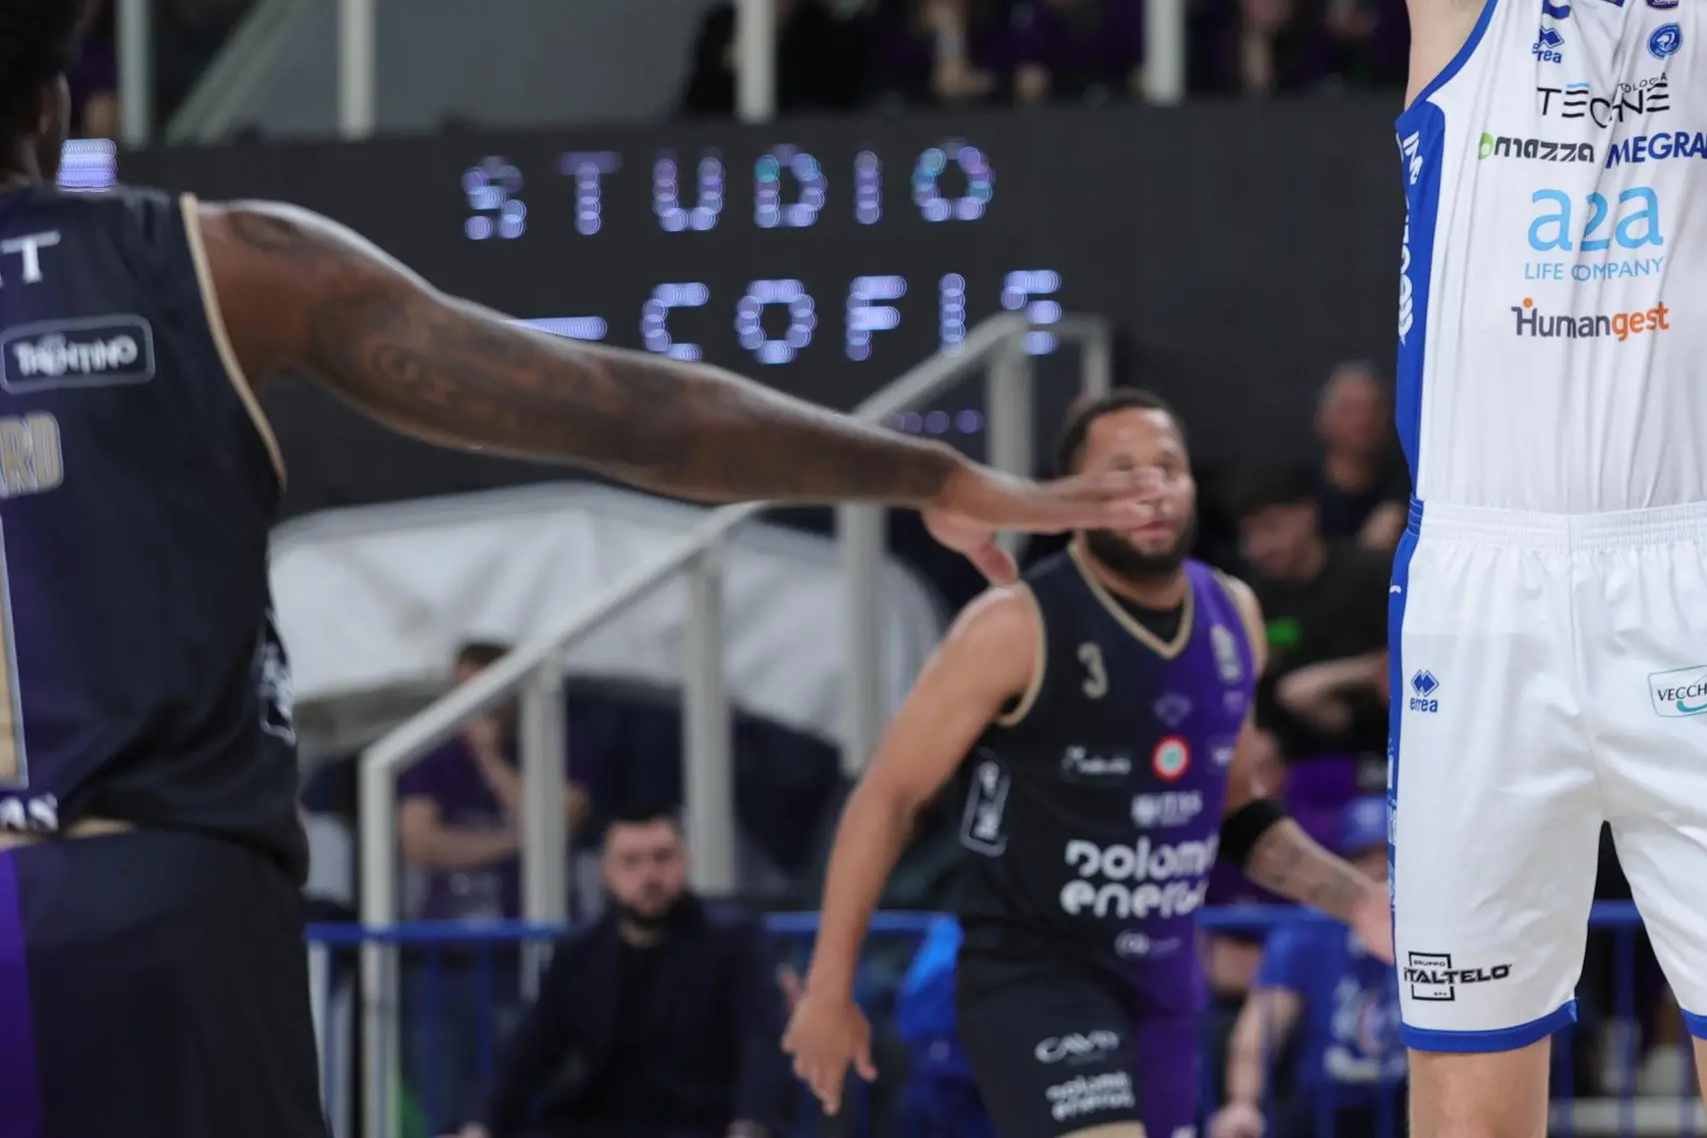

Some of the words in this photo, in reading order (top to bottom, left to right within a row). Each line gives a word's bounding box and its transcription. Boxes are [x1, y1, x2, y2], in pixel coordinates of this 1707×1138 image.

[1527, 186, 1664, 252] a2a
[1524, 263, 1564, 280] LIFE
[1511, 297, 1669, 342] Humangest
[1077, 643, 1108, 699] 3
